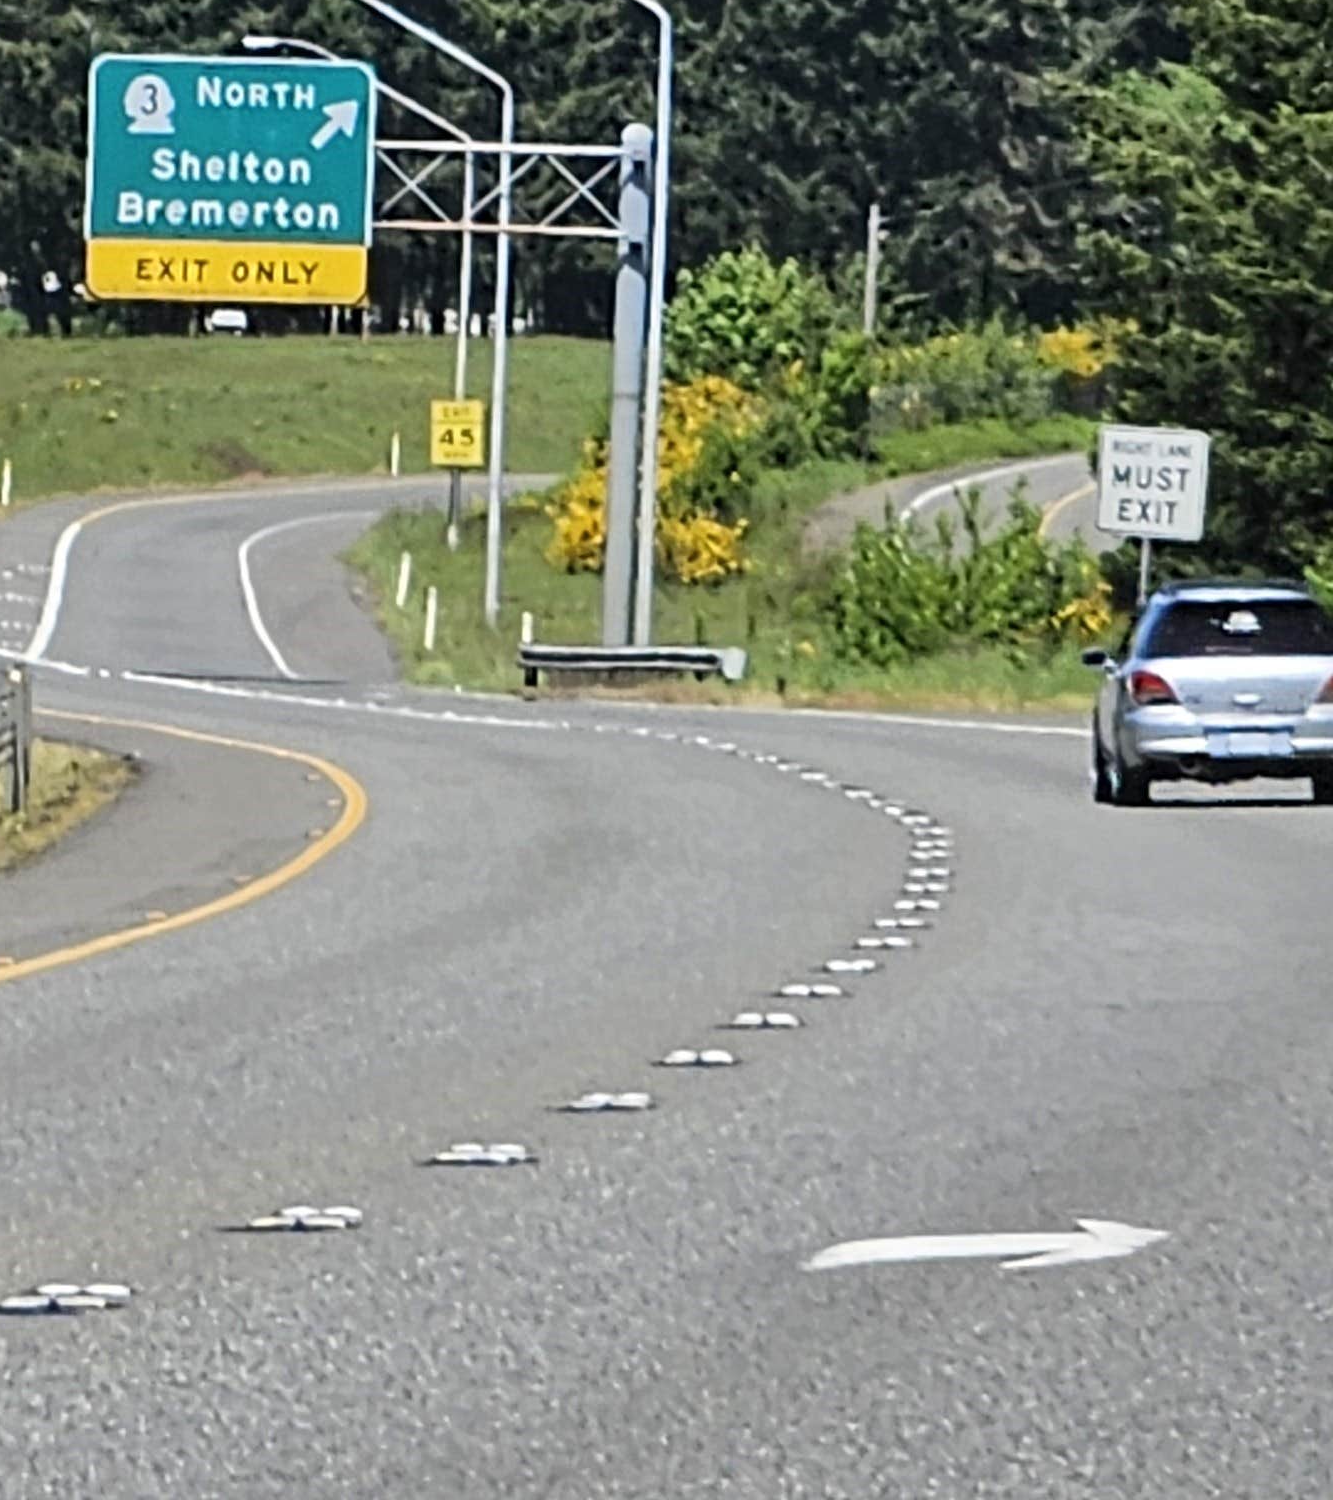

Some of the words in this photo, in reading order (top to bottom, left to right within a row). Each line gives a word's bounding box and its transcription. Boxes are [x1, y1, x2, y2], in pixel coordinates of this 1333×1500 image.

[139, 83, 160, 116] 3
[196, 76, 316, 110] NORTH
[151, 148, 312, 184] Shelton
[117, 192, 339, 231] Bremerton
[135, 258, 210, 282] EXIT
[232, 261, 320, 285] ONLY
[439, 428, 475, 447] 45
[1112, 464, 1191, 492] MUST
[1118, 498, 1177, 524] EXIT
